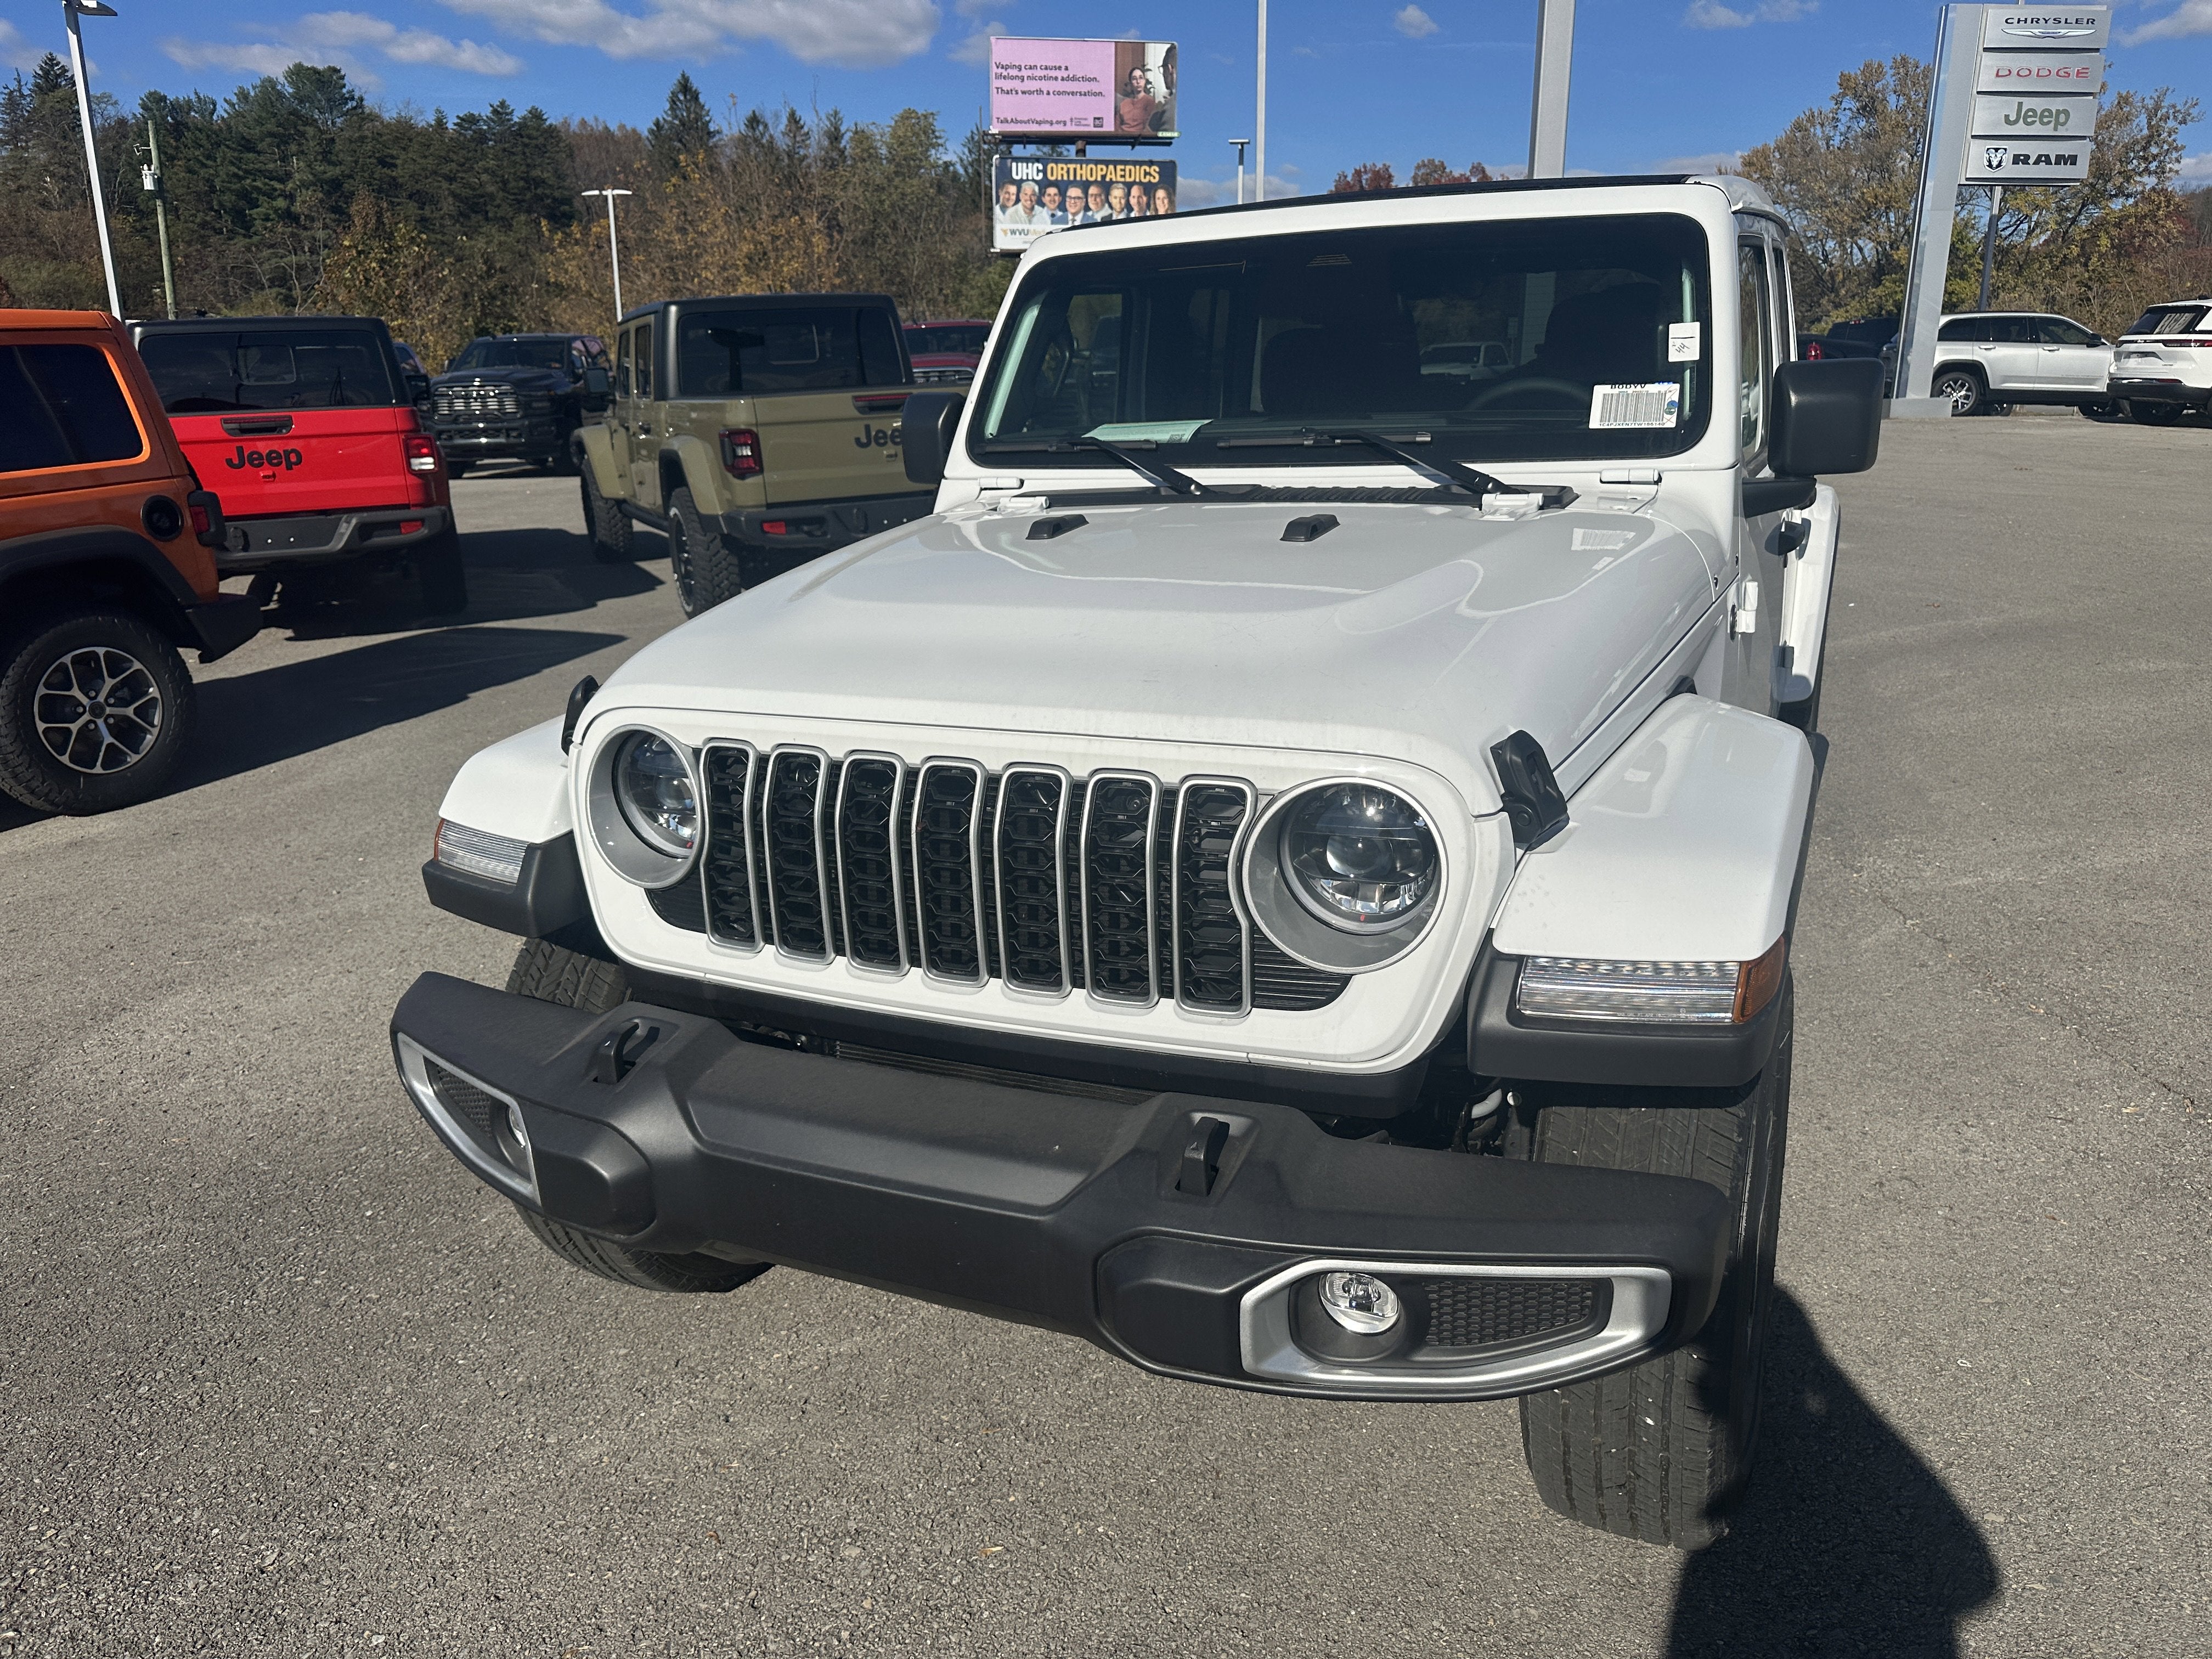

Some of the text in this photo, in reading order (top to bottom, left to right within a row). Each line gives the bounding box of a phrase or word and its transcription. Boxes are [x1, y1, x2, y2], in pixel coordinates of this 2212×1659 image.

[2004, 17, 2096, 25] CHRYSLER
[995, 62, 1022, 72] Vaping
[1995, 66, 2090, 78] DODGE
[995, 72, 1100, 83] lifelong nicotine addiction.
[995, 87, 1019, 95] That's
[1021, 88, 1044, 96] worth
[1052, 89, 1106, 98] conversation.
[995, 117, 1067, 127] TalkAboutVaping.org
[2004, 101, 2070, 132] Jeep
[2011, 154, 2078, 166] RAM
[1012, 162, 1160, 183] UHC ORTHOPAEDICS
[855, 424, 902, 449] Jee
[225, 445, 303, 471] Jeep
